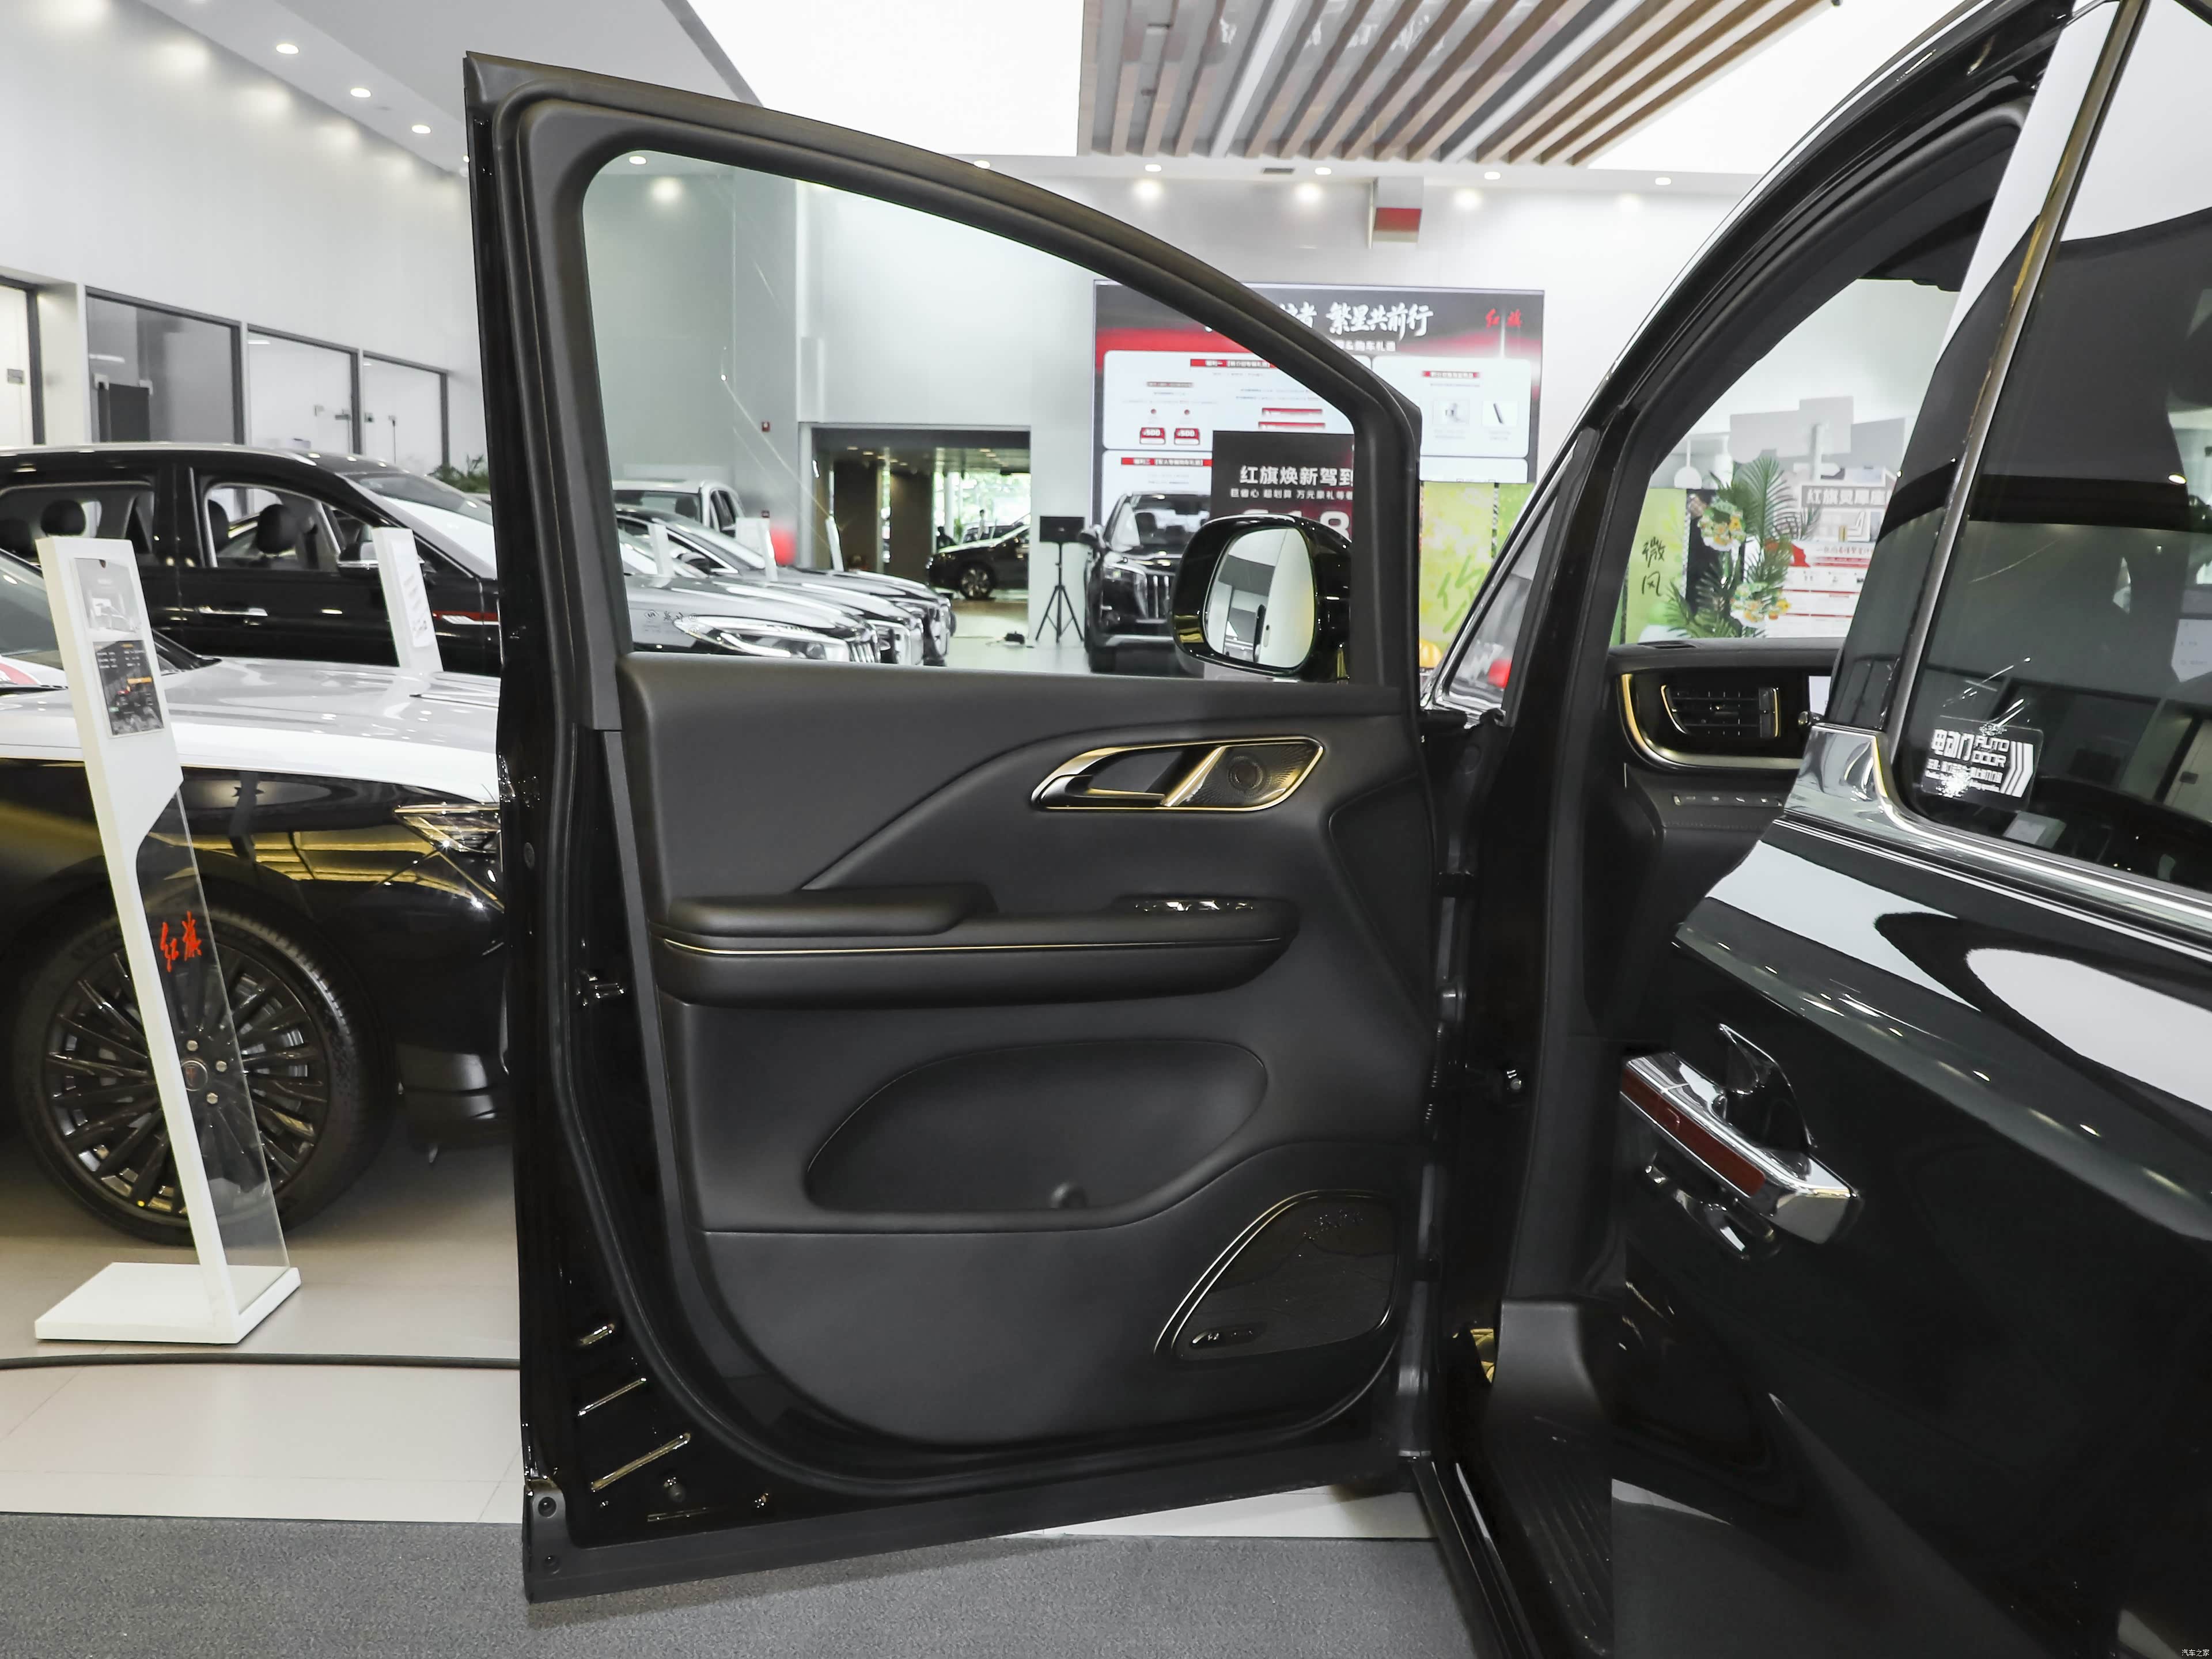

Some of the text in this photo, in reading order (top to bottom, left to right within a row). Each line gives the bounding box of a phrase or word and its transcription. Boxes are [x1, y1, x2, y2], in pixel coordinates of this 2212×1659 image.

[1325, 301, 1434, 341] 繁星共前行
[1239, 465, 1353, 487] 红旗焕新驾到
[1974, 734, 2010, 752] AUTO
[1971, 750, 2007, 768] DOOR
